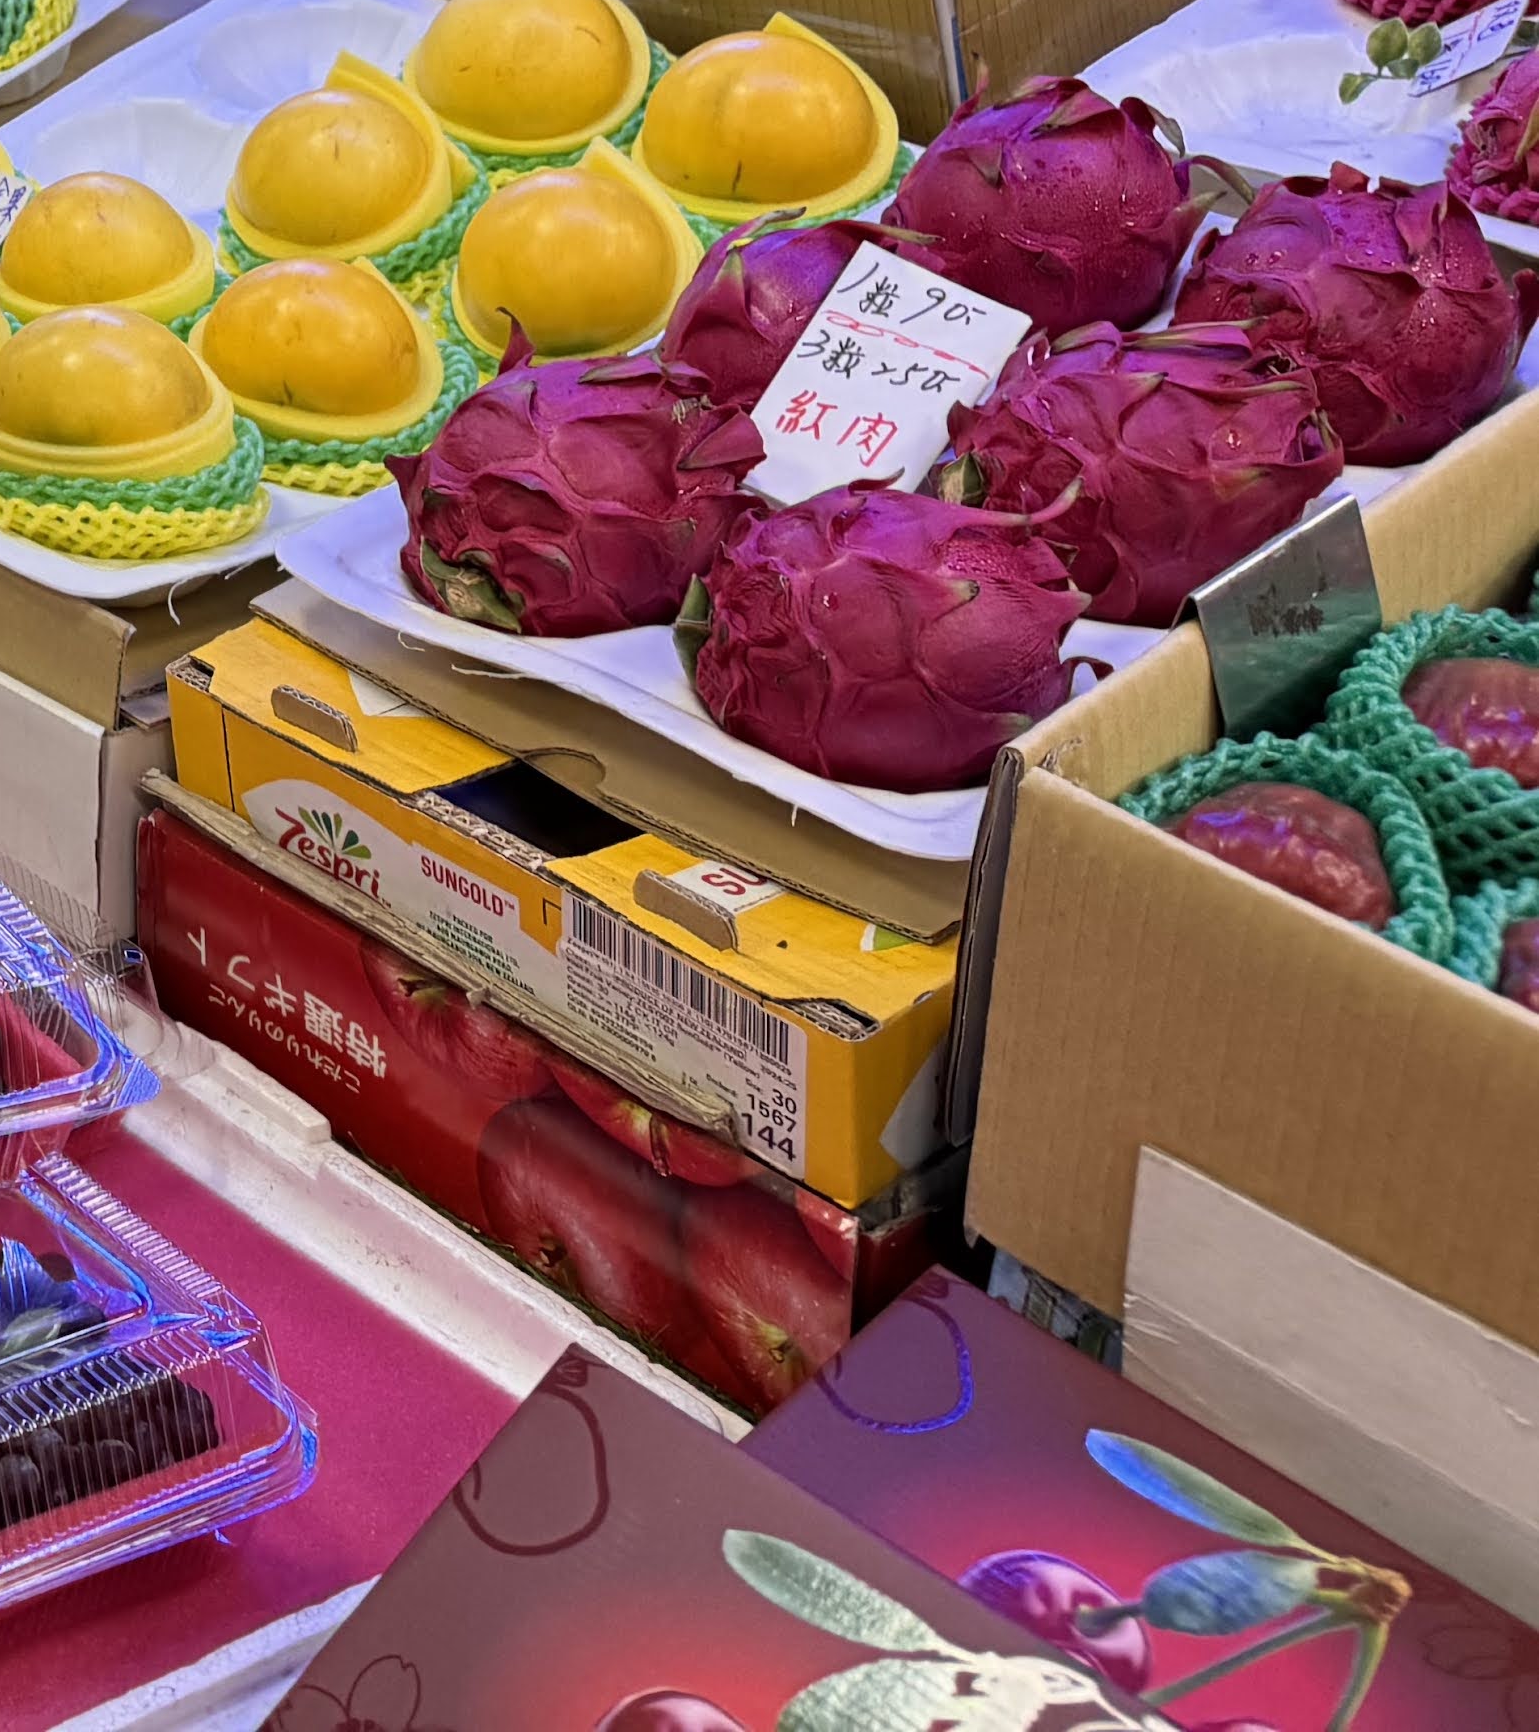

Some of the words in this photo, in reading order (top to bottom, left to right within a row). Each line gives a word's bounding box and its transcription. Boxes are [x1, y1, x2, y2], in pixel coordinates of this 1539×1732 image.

[775, 389, 898, 468] 紅肉
[188, 927, 386, 1078] 特選ギフト
[748, 1094, 797, 1132] 1567
[773, 1088, 797, 1115] 30
[741, 1112, 795, 1162] 144
